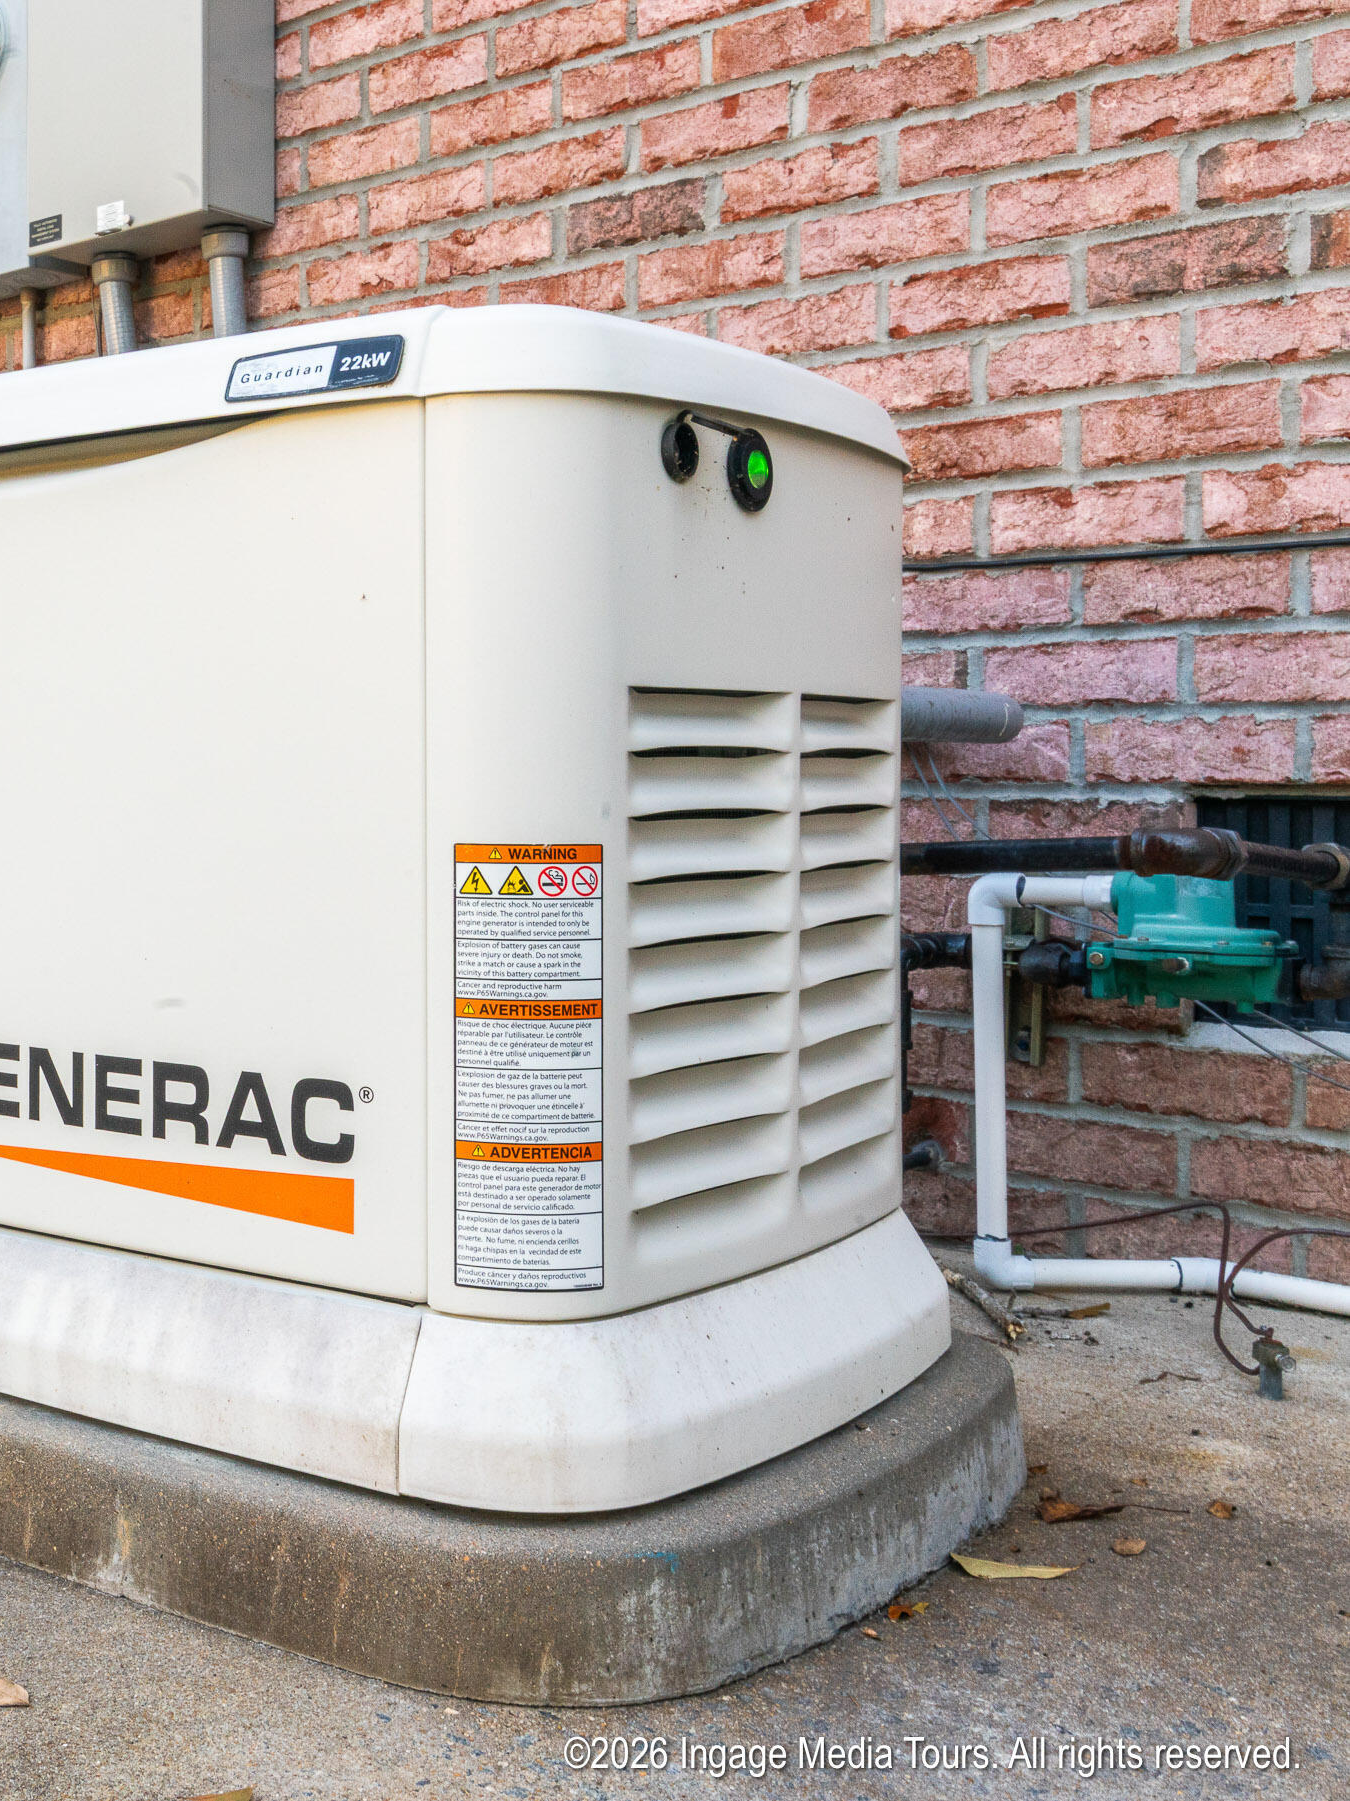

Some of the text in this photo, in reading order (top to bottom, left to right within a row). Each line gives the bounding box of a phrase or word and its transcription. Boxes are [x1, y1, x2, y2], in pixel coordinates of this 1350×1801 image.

[340, 352, 391, 371] 22kW
[241, 364, 323, 384] Guardian
[509, 848, 577, 860] WARNING
[531, 900, 542, 908] No
[559, 899, 593, 908] serviceable
[540, 909, 560, 919] panel
[561, 909, 570, 917] for
[571, 909, 583, 917] this
[525, 919, 557, 927] intended
[581, 918, 589, 926] be
[543, 960, 562, 969] spark
[570, 959, 581, 967] the
[506, 969, 532, 979] battery
[497, 981, 542, 991] reproductive
[543, 981, 561, 990] harm
[480, 1003, 597, 1017] AVERTISSEMENT
[548, 1020, 574, 1029] Aucune
[545, 1030, 554, 1038] Le
[549, 1040, 558, 1048] de
[507, 1073, 520, 1081] gaz
[521, 1071, 531, 1079] de
[539, 1071, 566, 1079] batterie
[567, 1072, 582, 1081] peut
[563, 1081, 569, 1089] la
[498, 1103, 535, 1111] provoquer
[560, 1111, 570, 1119] de
[547, 1124, 589, 1135] reproduction
[490, 1146, 592, 1160] ADVERTENCIA
[557, 1164, 568, 1172] No
[537, 1183, 573, 1193] generador
[574, 1182, 582, 1190] de
[583, 1182, 601, 1190] motor
[557, 1191, 590, 1200] solamente
[559, 1247, 568, 1255] de
